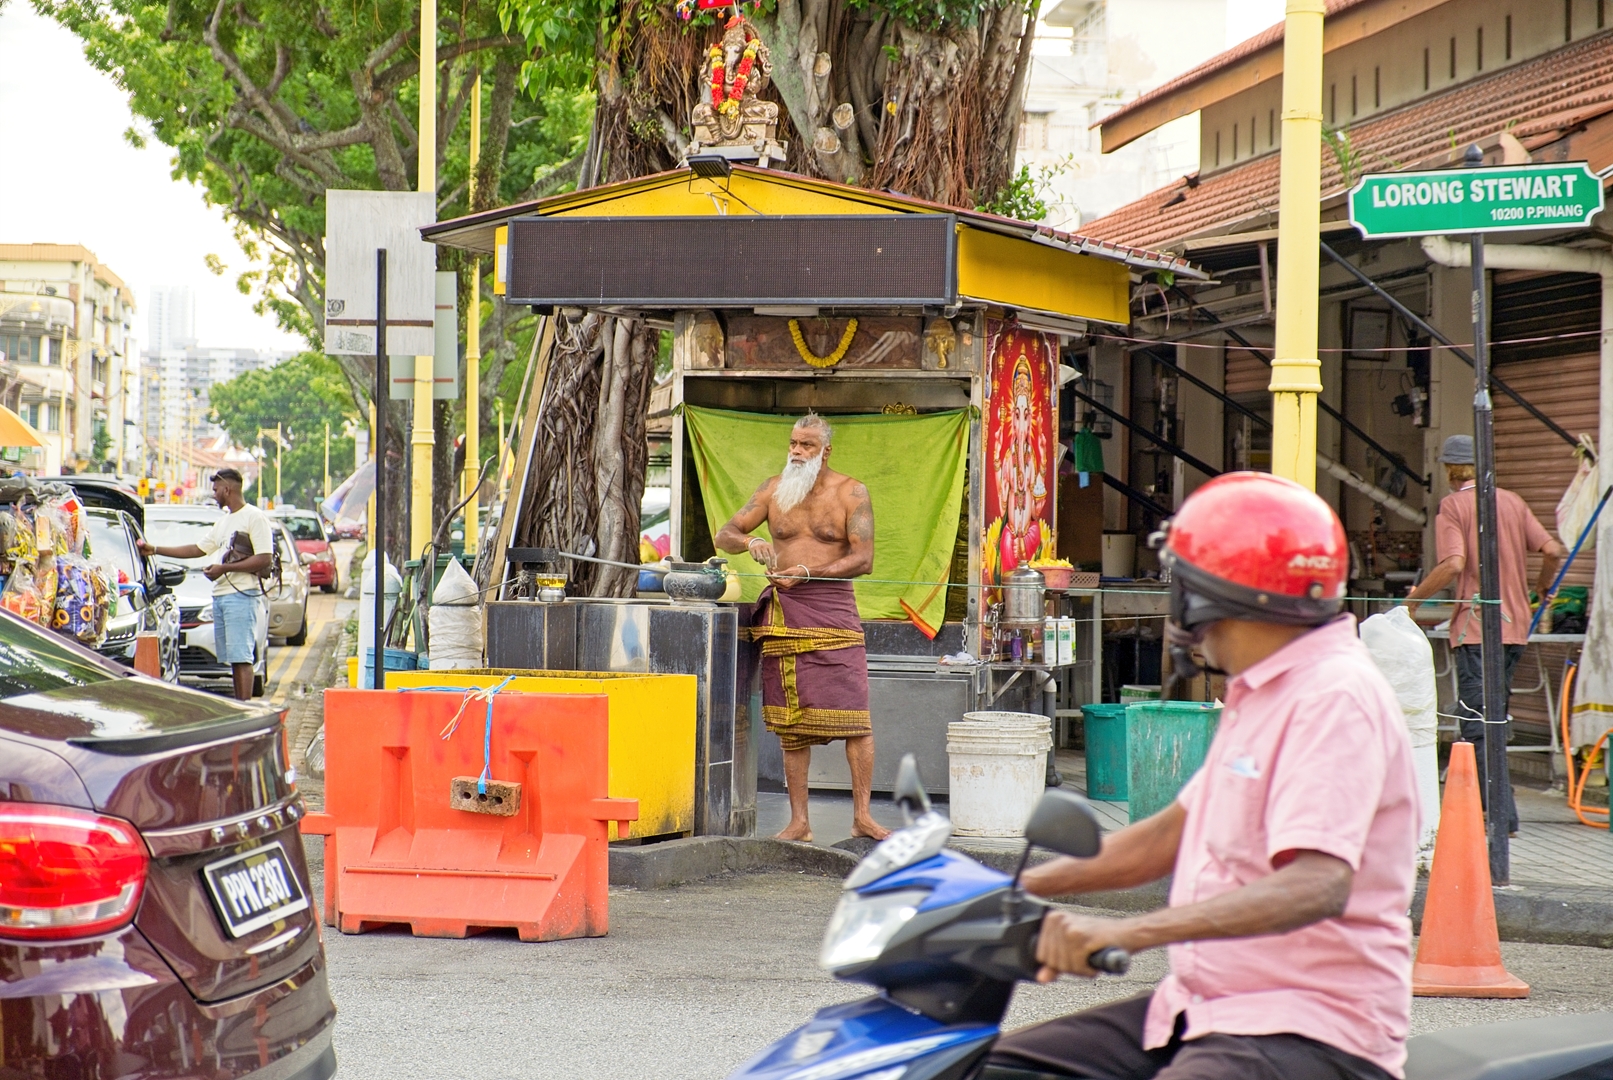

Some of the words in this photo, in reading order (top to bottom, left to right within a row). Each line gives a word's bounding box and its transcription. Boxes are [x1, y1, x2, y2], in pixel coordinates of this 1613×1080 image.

[1372, 181, 1464, 208] LORONG
[1470, 174, 1577, 202] STEWART
[1490, 207, 1524, 221] 10200
[1526, 204, 1583, 219] P.PINANG
